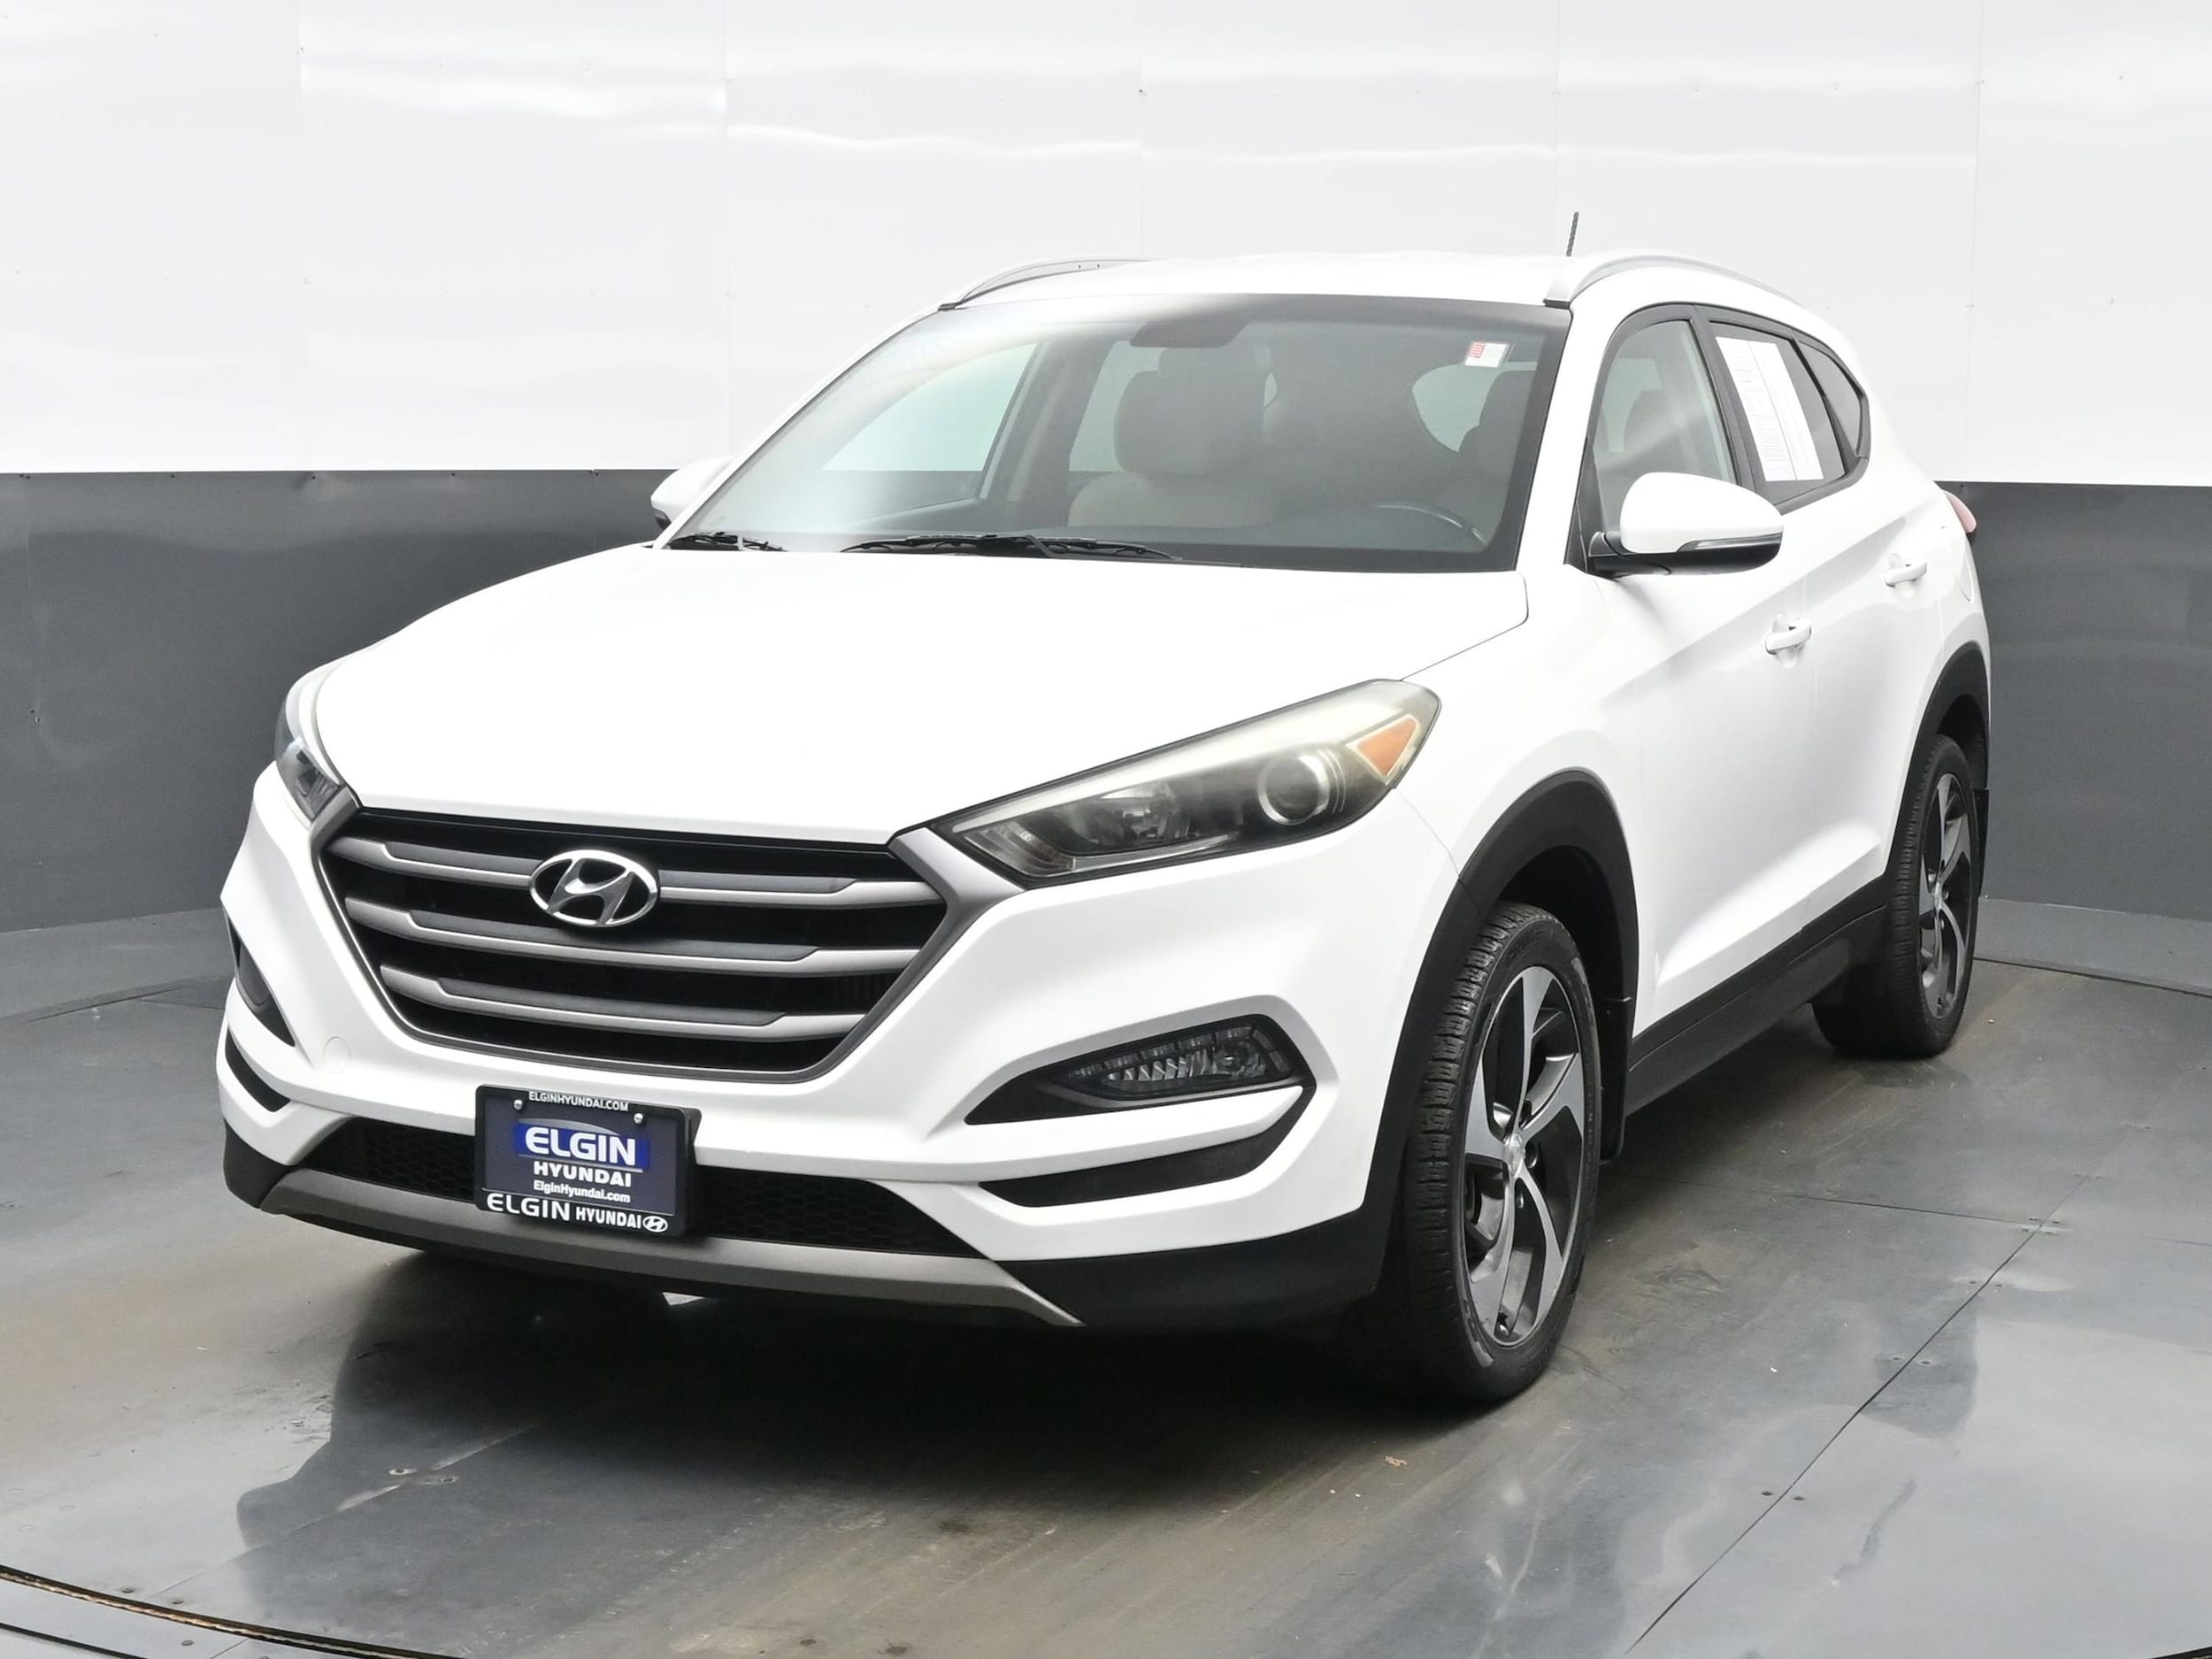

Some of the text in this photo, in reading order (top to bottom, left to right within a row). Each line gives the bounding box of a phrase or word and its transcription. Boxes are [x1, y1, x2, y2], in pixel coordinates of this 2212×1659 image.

[529, 1091, 628, 1111] ELGINHYUNDAI.COM
[526, 1126, 635, 1165] ELGIN
[534, 1161, 631, 1187] HYUNDAI
[534, 1180, 630, 1203] ElginHyundai.com
[487, 1194, 641, 1229] ELGIN HYUNDAI
